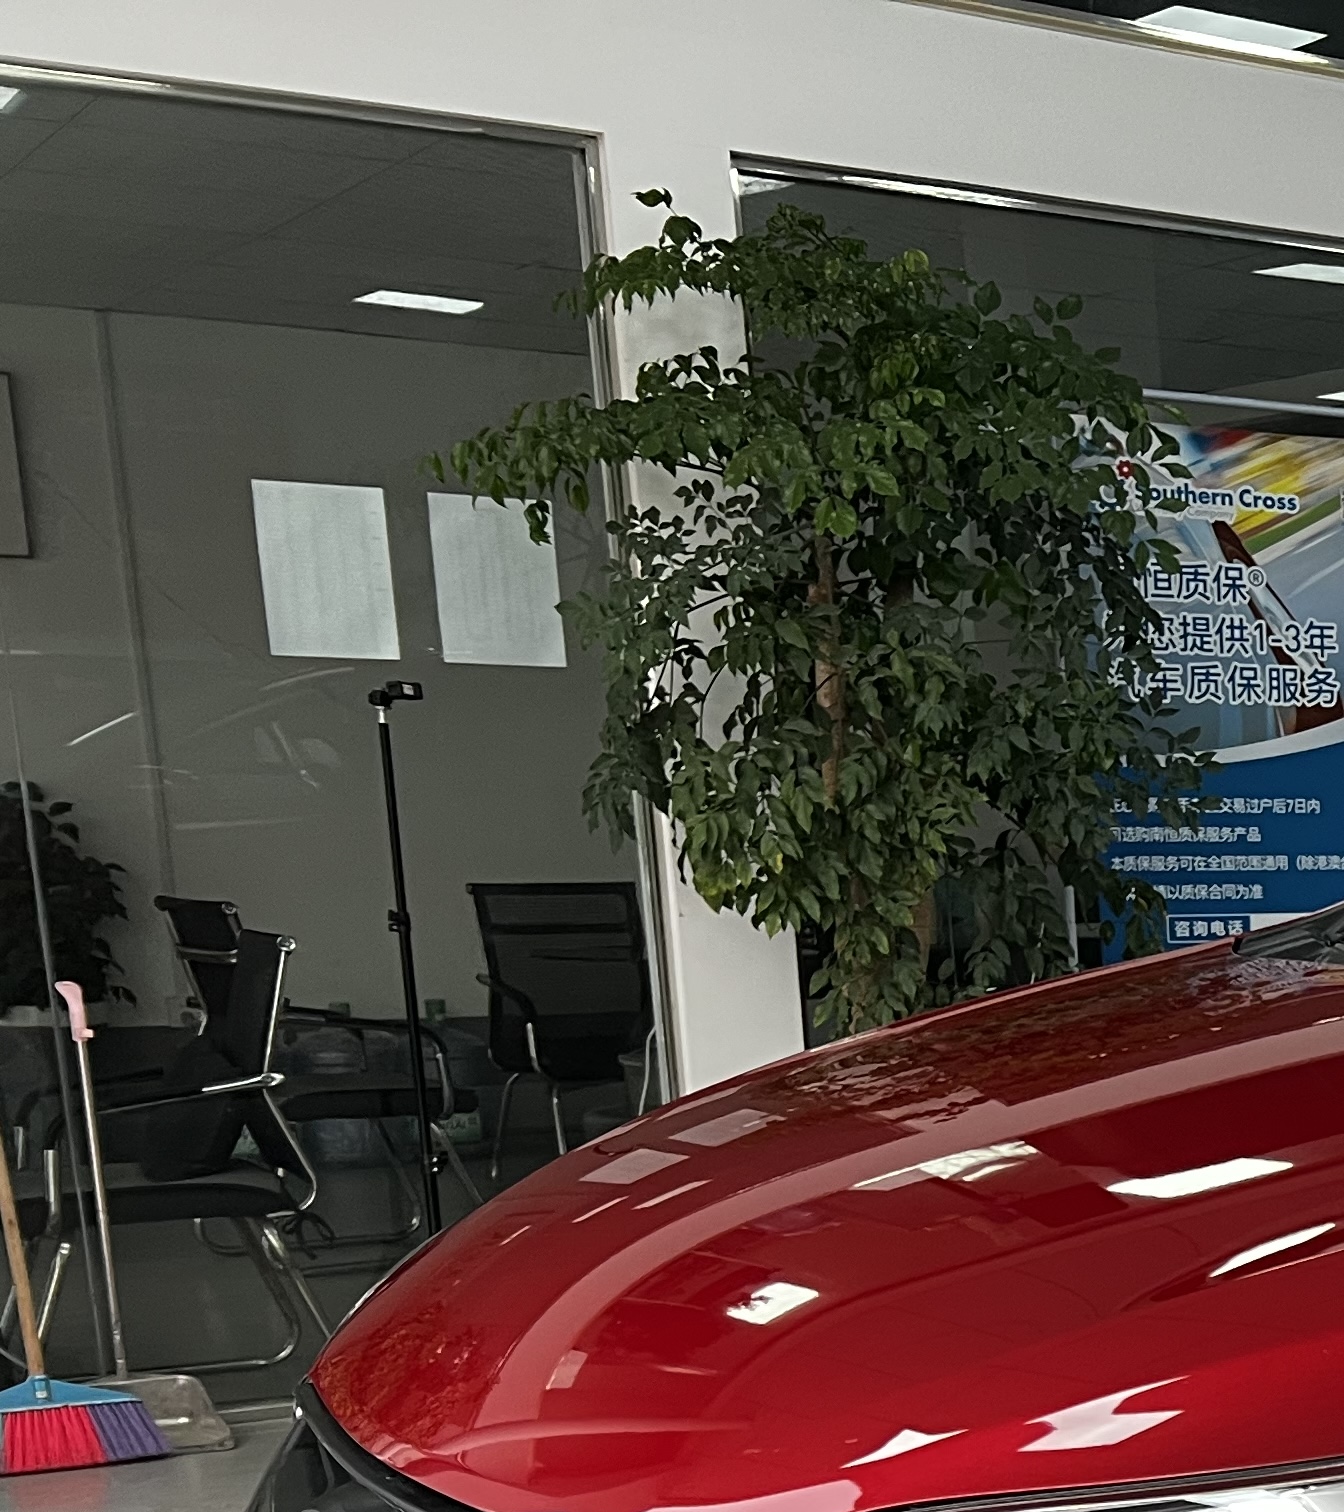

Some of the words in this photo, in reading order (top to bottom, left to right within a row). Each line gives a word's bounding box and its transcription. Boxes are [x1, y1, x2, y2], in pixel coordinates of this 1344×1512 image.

[1138, 483, 1234, 507] outhern
[1239, 488, 1297, 511] Cross
[1174, 920, 1244, 937] 咨询电话
